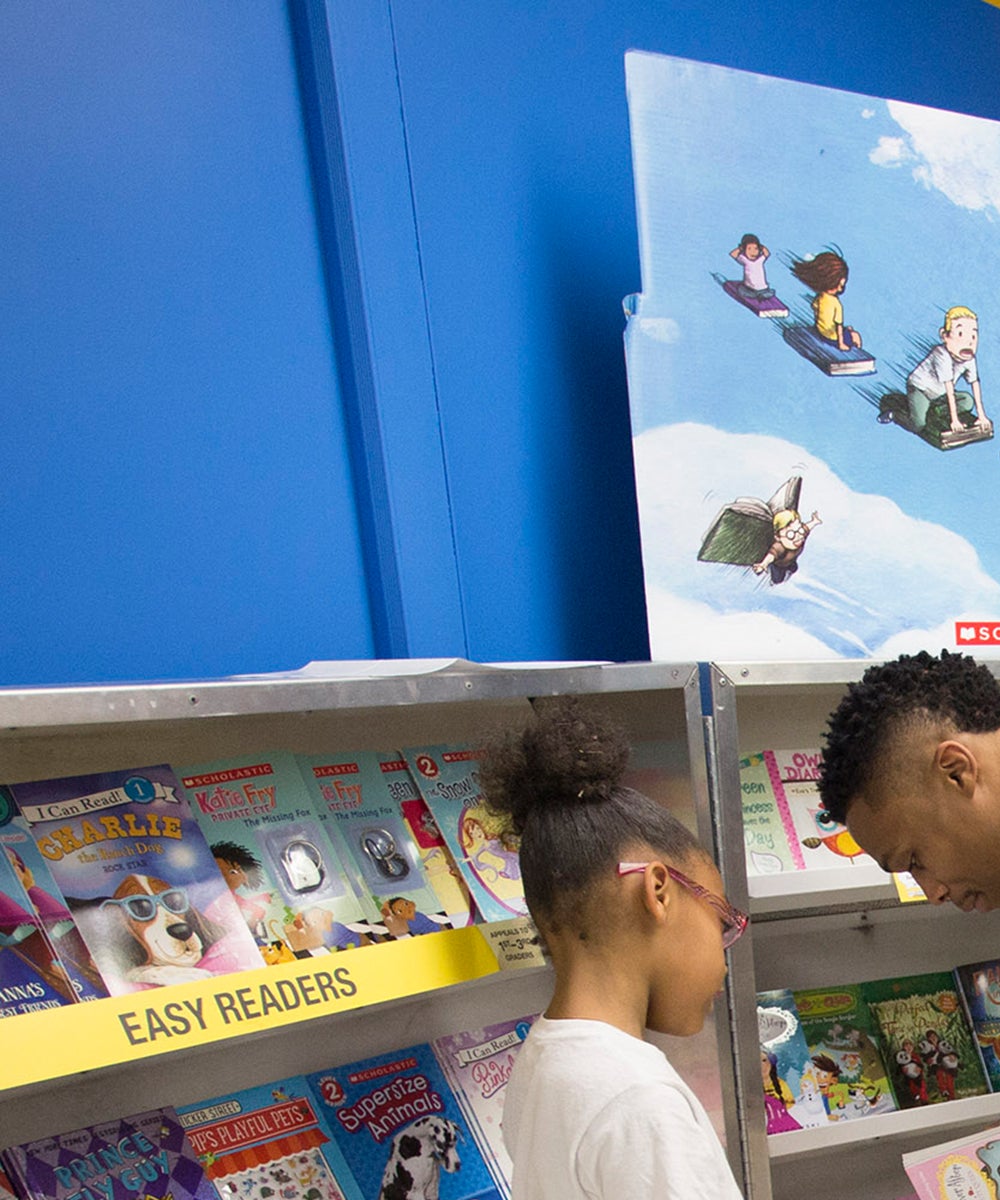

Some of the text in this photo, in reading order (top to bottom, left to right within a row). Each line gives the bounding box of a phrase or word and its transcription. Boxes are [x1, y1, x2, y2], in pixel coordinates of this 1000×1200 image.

[195, 764, 272, 785] SCHOLASTIC
[420, 758, 435, 775] 2
[133, 782, 145, 797] 1
[194, 782, 277, 815] Katie Fry
[436, 777, 472, 800] Snow
[35, 790, 123, 820] I Can Read!
[210, 803, 271, 823] PRIVATE EYE
[334, 812, 350, 821] The
[350, 809, 379, 820] Missing
[379, 806, 393, 815] Fox
[243, 817, 260, 828] The
[261, 812, 295, 826] Missing
[294, 807, 312, 818] Fox
[36, 812, 184, 862] CHARLIE
[745, 828, 776, 850] Day
[134, 842, 164, 856] Dog
[102, 859, 149, 874] ROCK STAR
[489, 926, 529, 939] APPEALS TO
[504, 951, 535, 961] GRADERS
[117, 966, 358, 1046] EASY READERS
[465, 1033, 516, 1060] I Can Read!
[357, 1058, 417, 1081] SCHOLASTIC
[325, 1082, 341, 1100] 2
[207, 1102, 237, 1118] STREET
[338, 1075, 428, 1131] Supersize
[216, 1104, 306, 1146] PLAYFUL PETS
[367, 1091, 442, 1141] Animals
[53, 1129, 154, 1190] PRINCE
[118, 1150, 171, 1191] GUY
